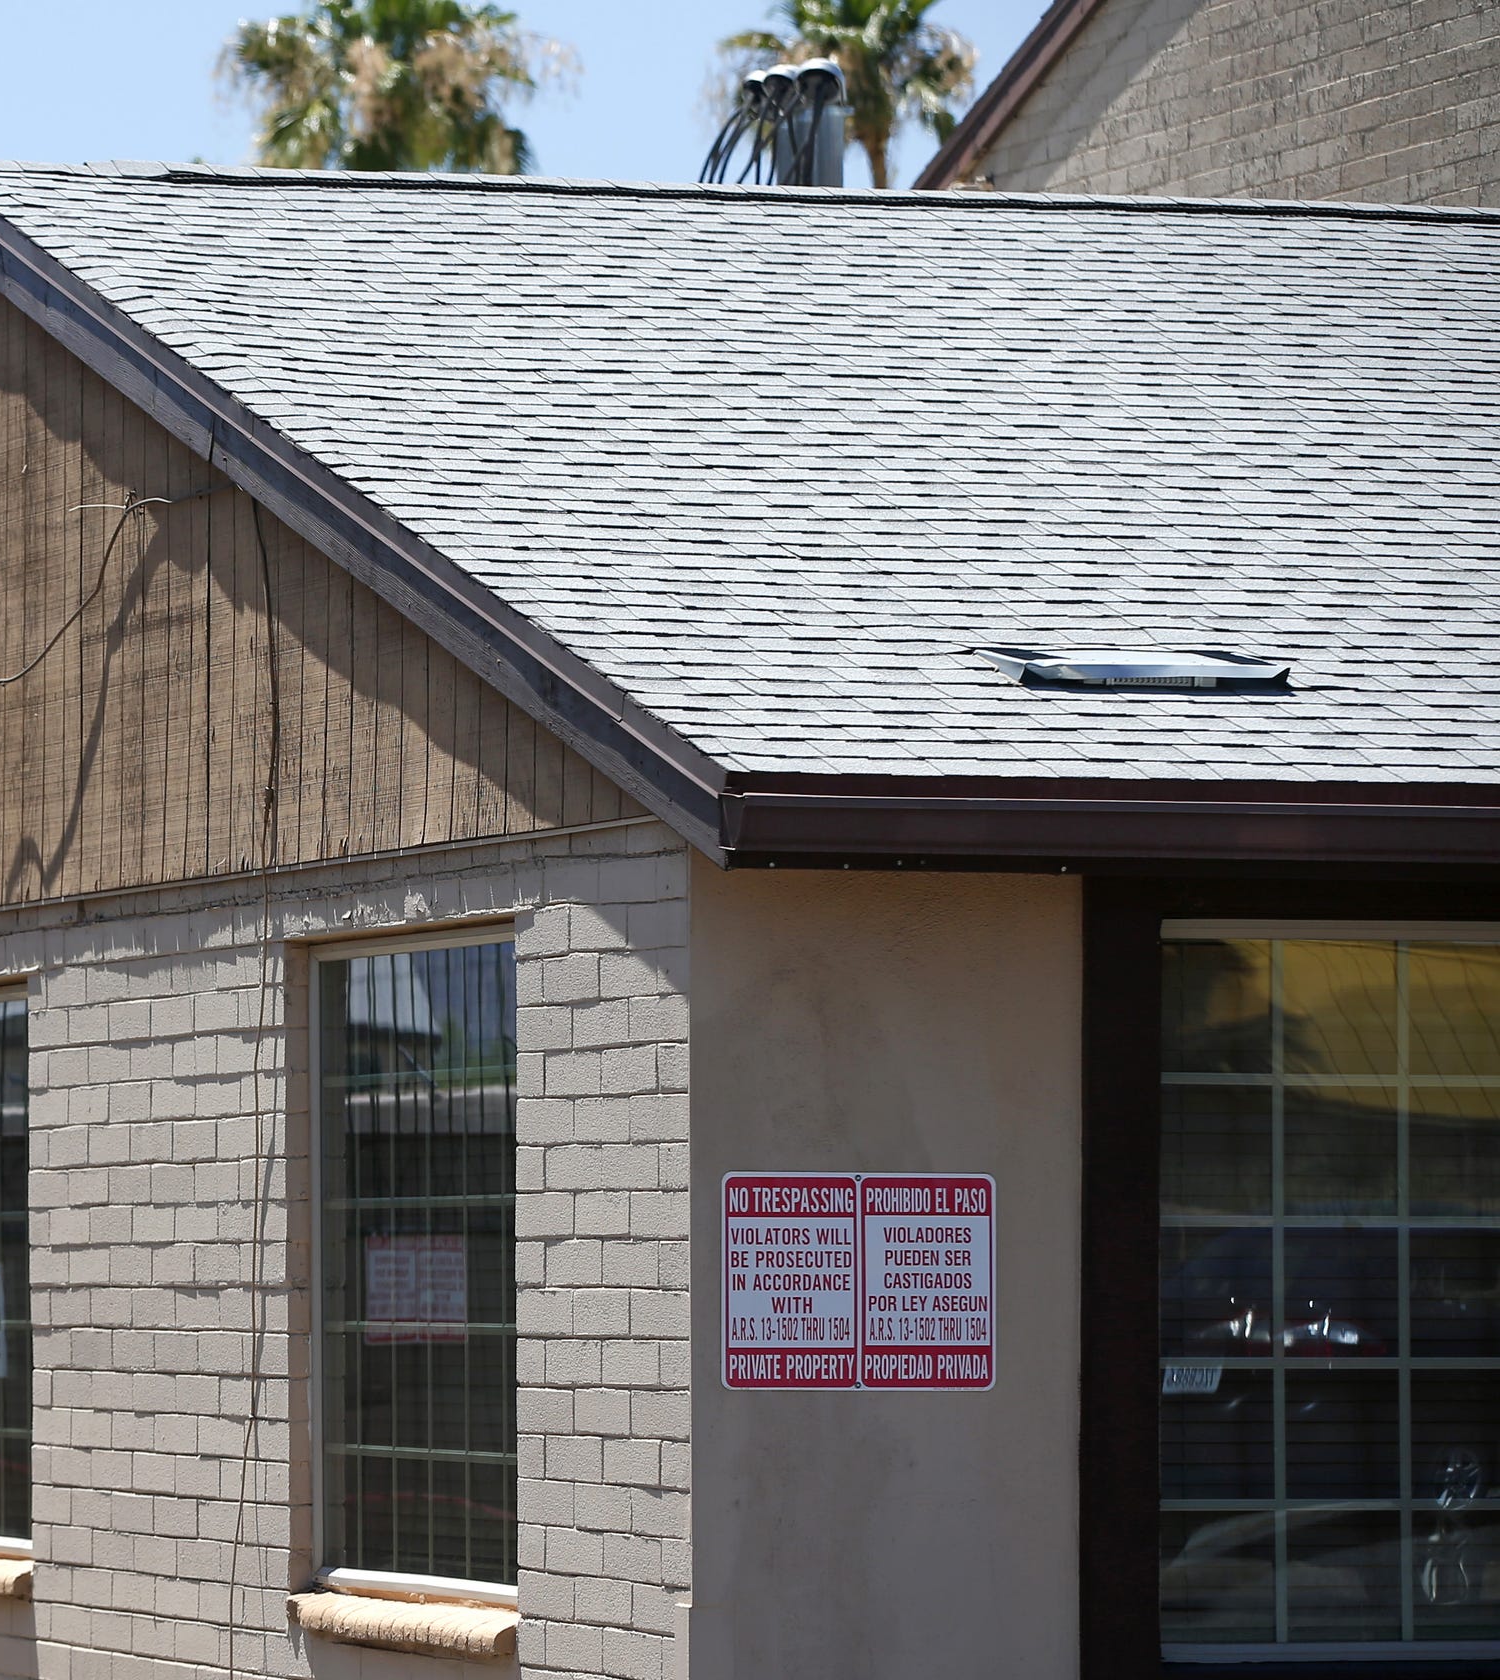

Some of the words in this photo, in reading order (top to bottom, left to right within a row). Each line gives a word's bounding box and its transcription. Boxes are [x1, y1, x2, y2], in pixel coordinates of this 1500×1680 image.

[729, 1187, 749, 1213] NO
[752, 1187, 854, 1213] TRESPASSING
[866, 1187, 931, 1213] PROHIBIDO
[935, 1187, 950, 1213] EL
[954, 1187, 986, 1213] PASO
[731, 1228, 811, 1245] VIOLATORS
[816, 1228, 852, 1245] WILL
[883, 1227, 972, 1243] VIOLADORES
[731, 1251, 749, 1268] BE
[755, 1251, 852, 1268] PROSECUTED
[884, 1250, 940, 1266] PUEDEN
[944, 1250, 972, 1266] SER
[732, 1273, 746, 1291] IN
[753, 1273, 851, 1291] ACCORDANCE
[883, 1272, 972, 1289] CASTIGADOS
[771, 1296, 813, 1314] WITH
[868, 1295, 897, 1312] POR
[901, 1295, 928, 1312] LEY
[932, 1295, 988, 1312] ASEGUN
[731, 1317, 758, 1341] A.R.S.
[761, 1317, 798, 1341] 13-1502
[801, 1317, 825, 1341] THRU
[828, 1317, 850, 1341] 1504
[869, 1317, 896, 1341] A.R.S.
[898, 1317, 936, 1341] 13-1502
[938, 1317, 962, 1341] THRU
[965, 1317, 987, 1341] 1504
[729, 1354, 781, 1379] PRIVATE
[786, 1354, 855, 1379] PROPERTY
[864, 1354, 933, 1380] PROPIEDAD
[937, 1354, 989, 1380] PRIVADA
